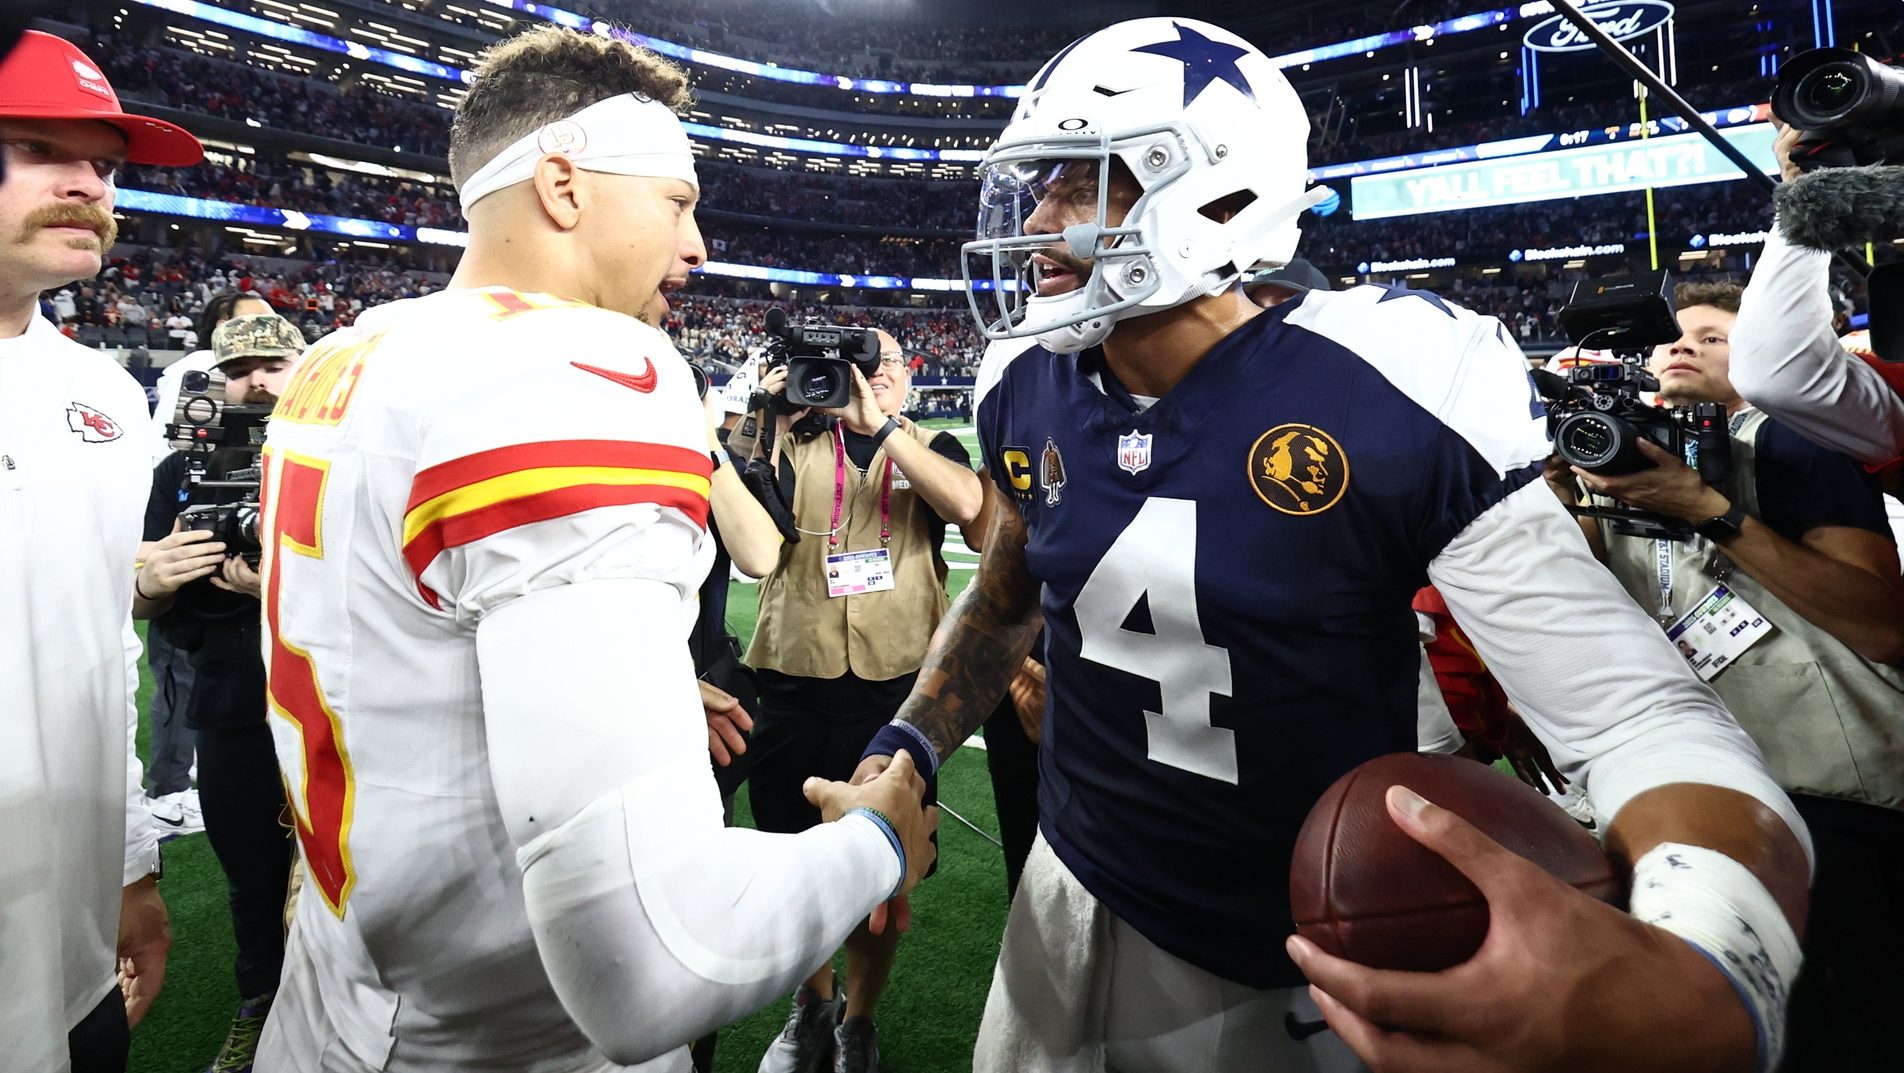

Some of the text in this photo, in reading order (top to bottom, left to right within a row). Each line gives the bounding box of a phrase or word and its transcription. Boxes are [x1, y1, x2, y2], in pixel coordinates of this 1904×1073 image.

[1493, 160, 1571, 195] FEEL
[1573, 143, 1706, 186] THAT?!
[1371, 257, 1456, 273] Blockchain.com
[1524, 244, 1624, 261] Blockchain.com
[79, 410, 115, 438] KC
[1003, 450, 1032, 491] C
[1123, 451, 1146, 467] NFL
[891, 479, 911, 490] MED
[1659, 554, 1671, 591] STADIUM
[1072, 496, 1239, 786] 4
